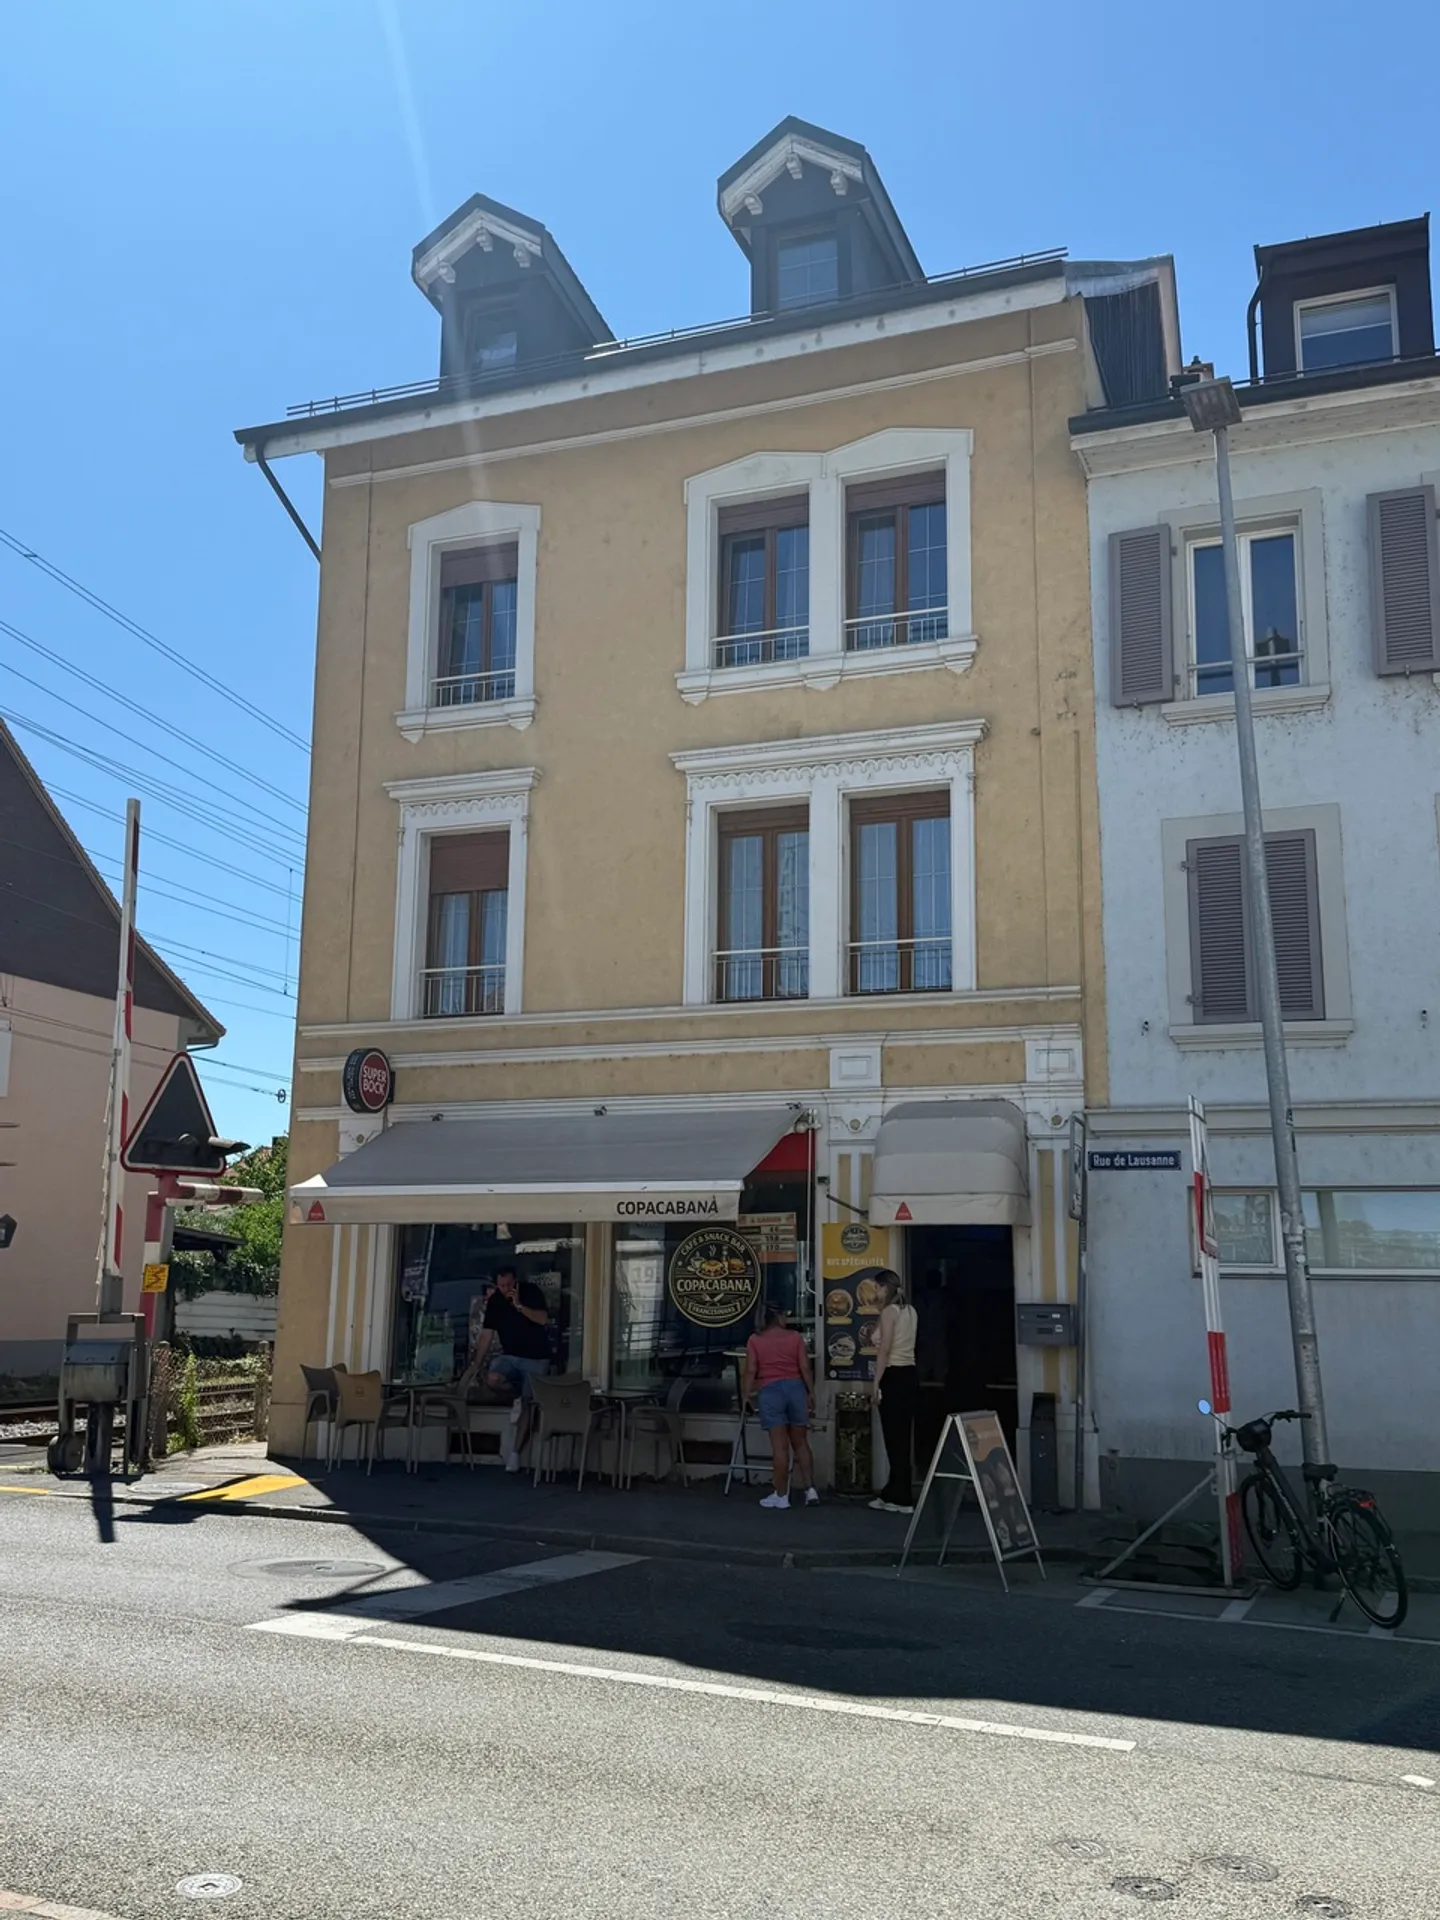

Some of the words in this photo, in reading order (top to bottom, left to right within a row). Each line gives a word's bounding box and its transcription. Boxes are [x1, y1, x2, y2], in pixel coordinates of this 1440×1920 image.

[363, 1065, 386, 1083] SUPER
[363, 1079, 385, 1096] BOCK
[1093, 1153, 1111, 1167] Rue
[1114, 1154, 1126, 1167] de
[1128, 1153, 1175, 1167] Lausanne
[704, 1232, 730, 1242] SNACK
[730, 1237, 745, 1254] BAR
[676, 1279, 752, 1292] COPACABANA
